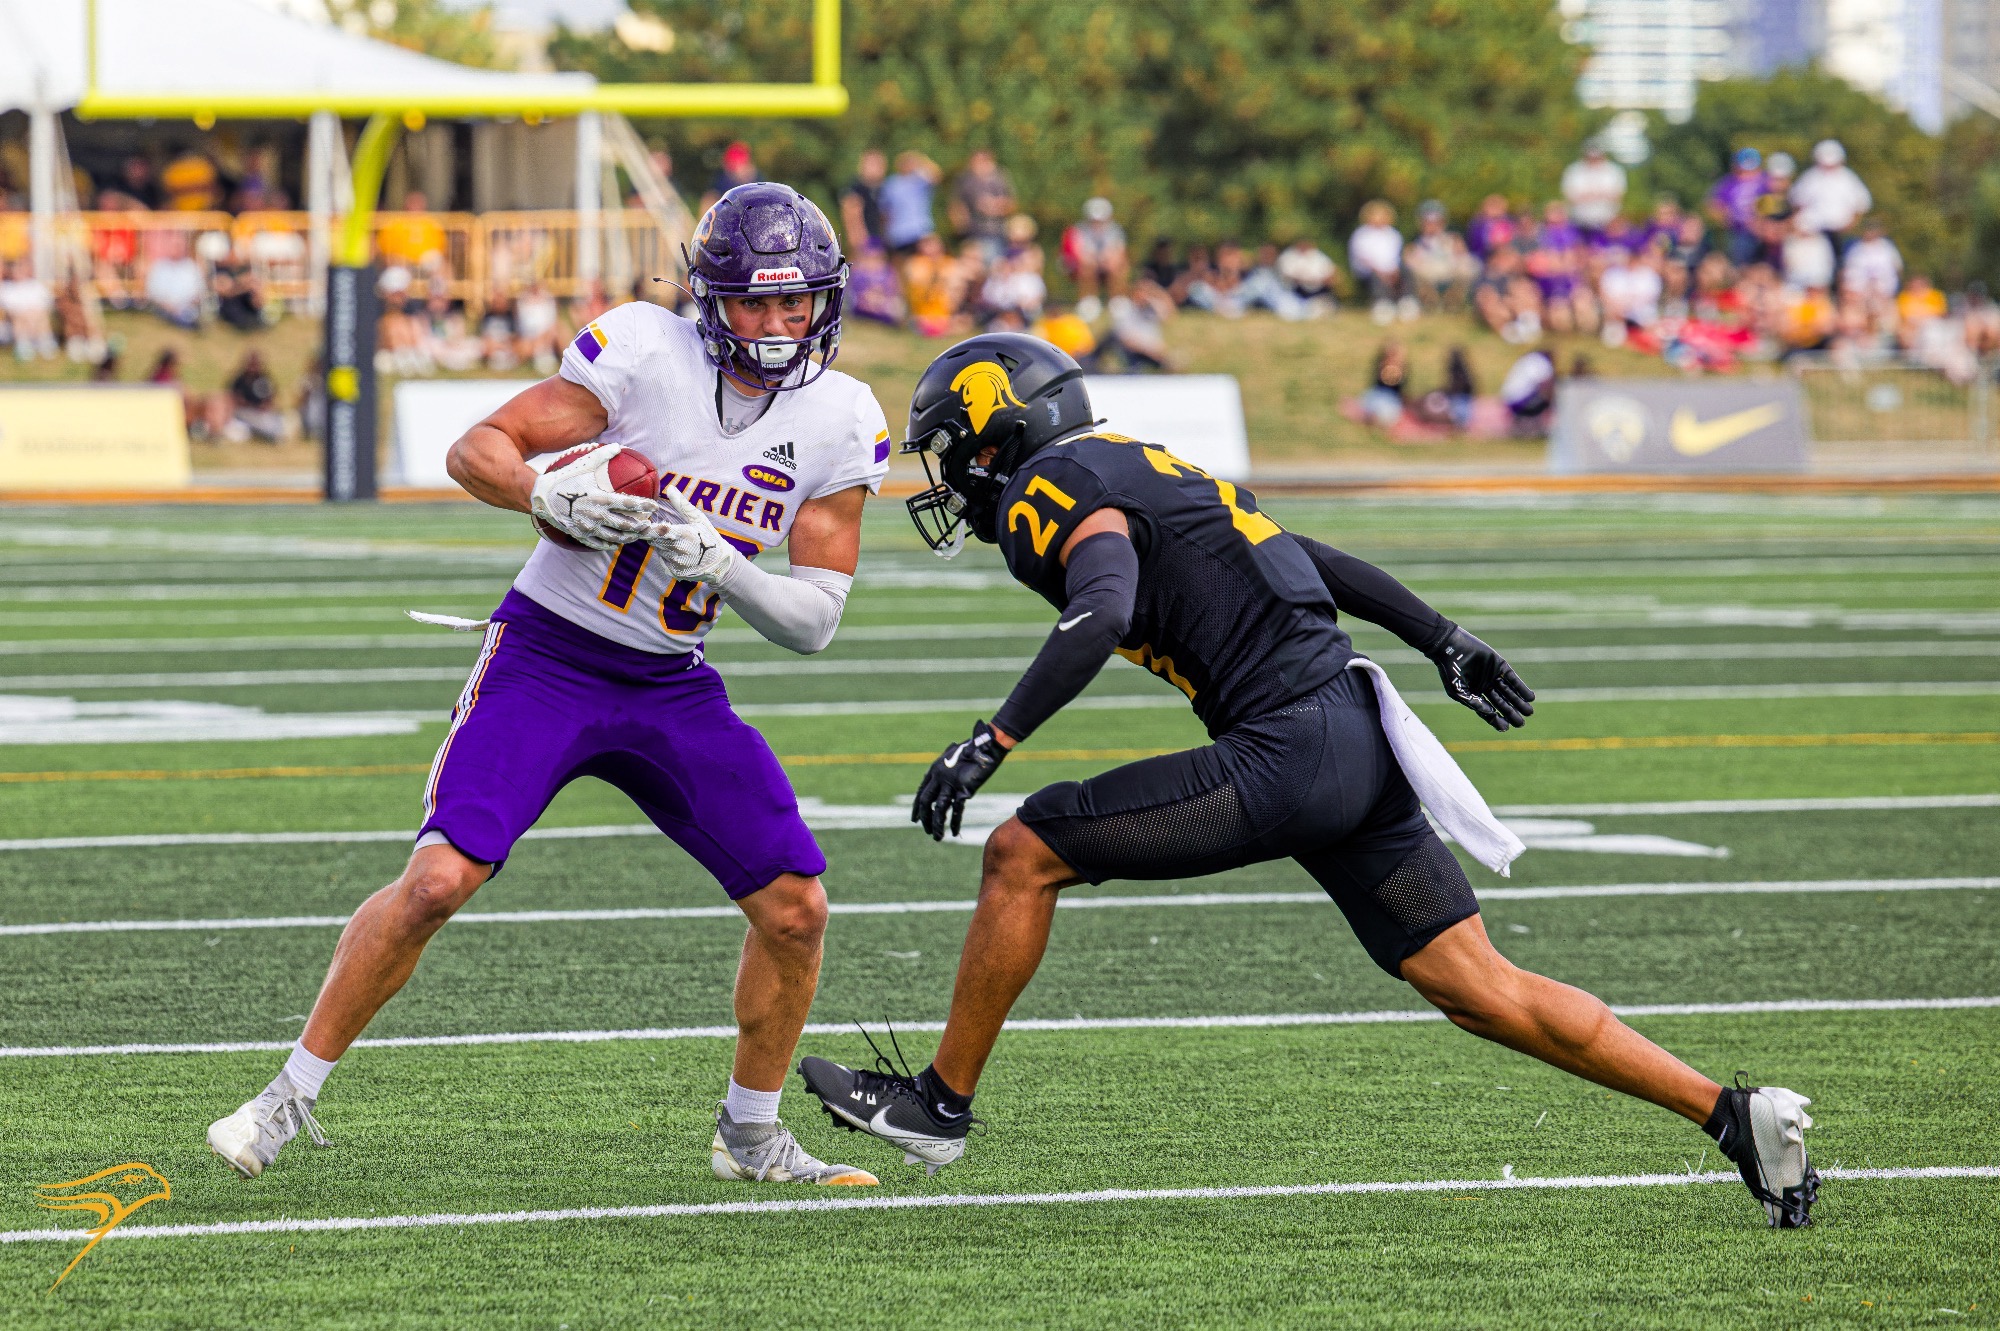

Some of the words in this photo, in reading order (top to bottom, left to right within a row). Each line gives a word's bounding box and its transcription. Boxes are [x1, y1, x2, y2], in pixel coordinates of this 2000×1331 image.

[757, 271, 798, 282] Riddell
[762, 450, 798, 471] adidas
[748, 468, 788, 489] OUA
[659, 471, 786, 533] URIER
[1008, 474, 1077, 557] 21
